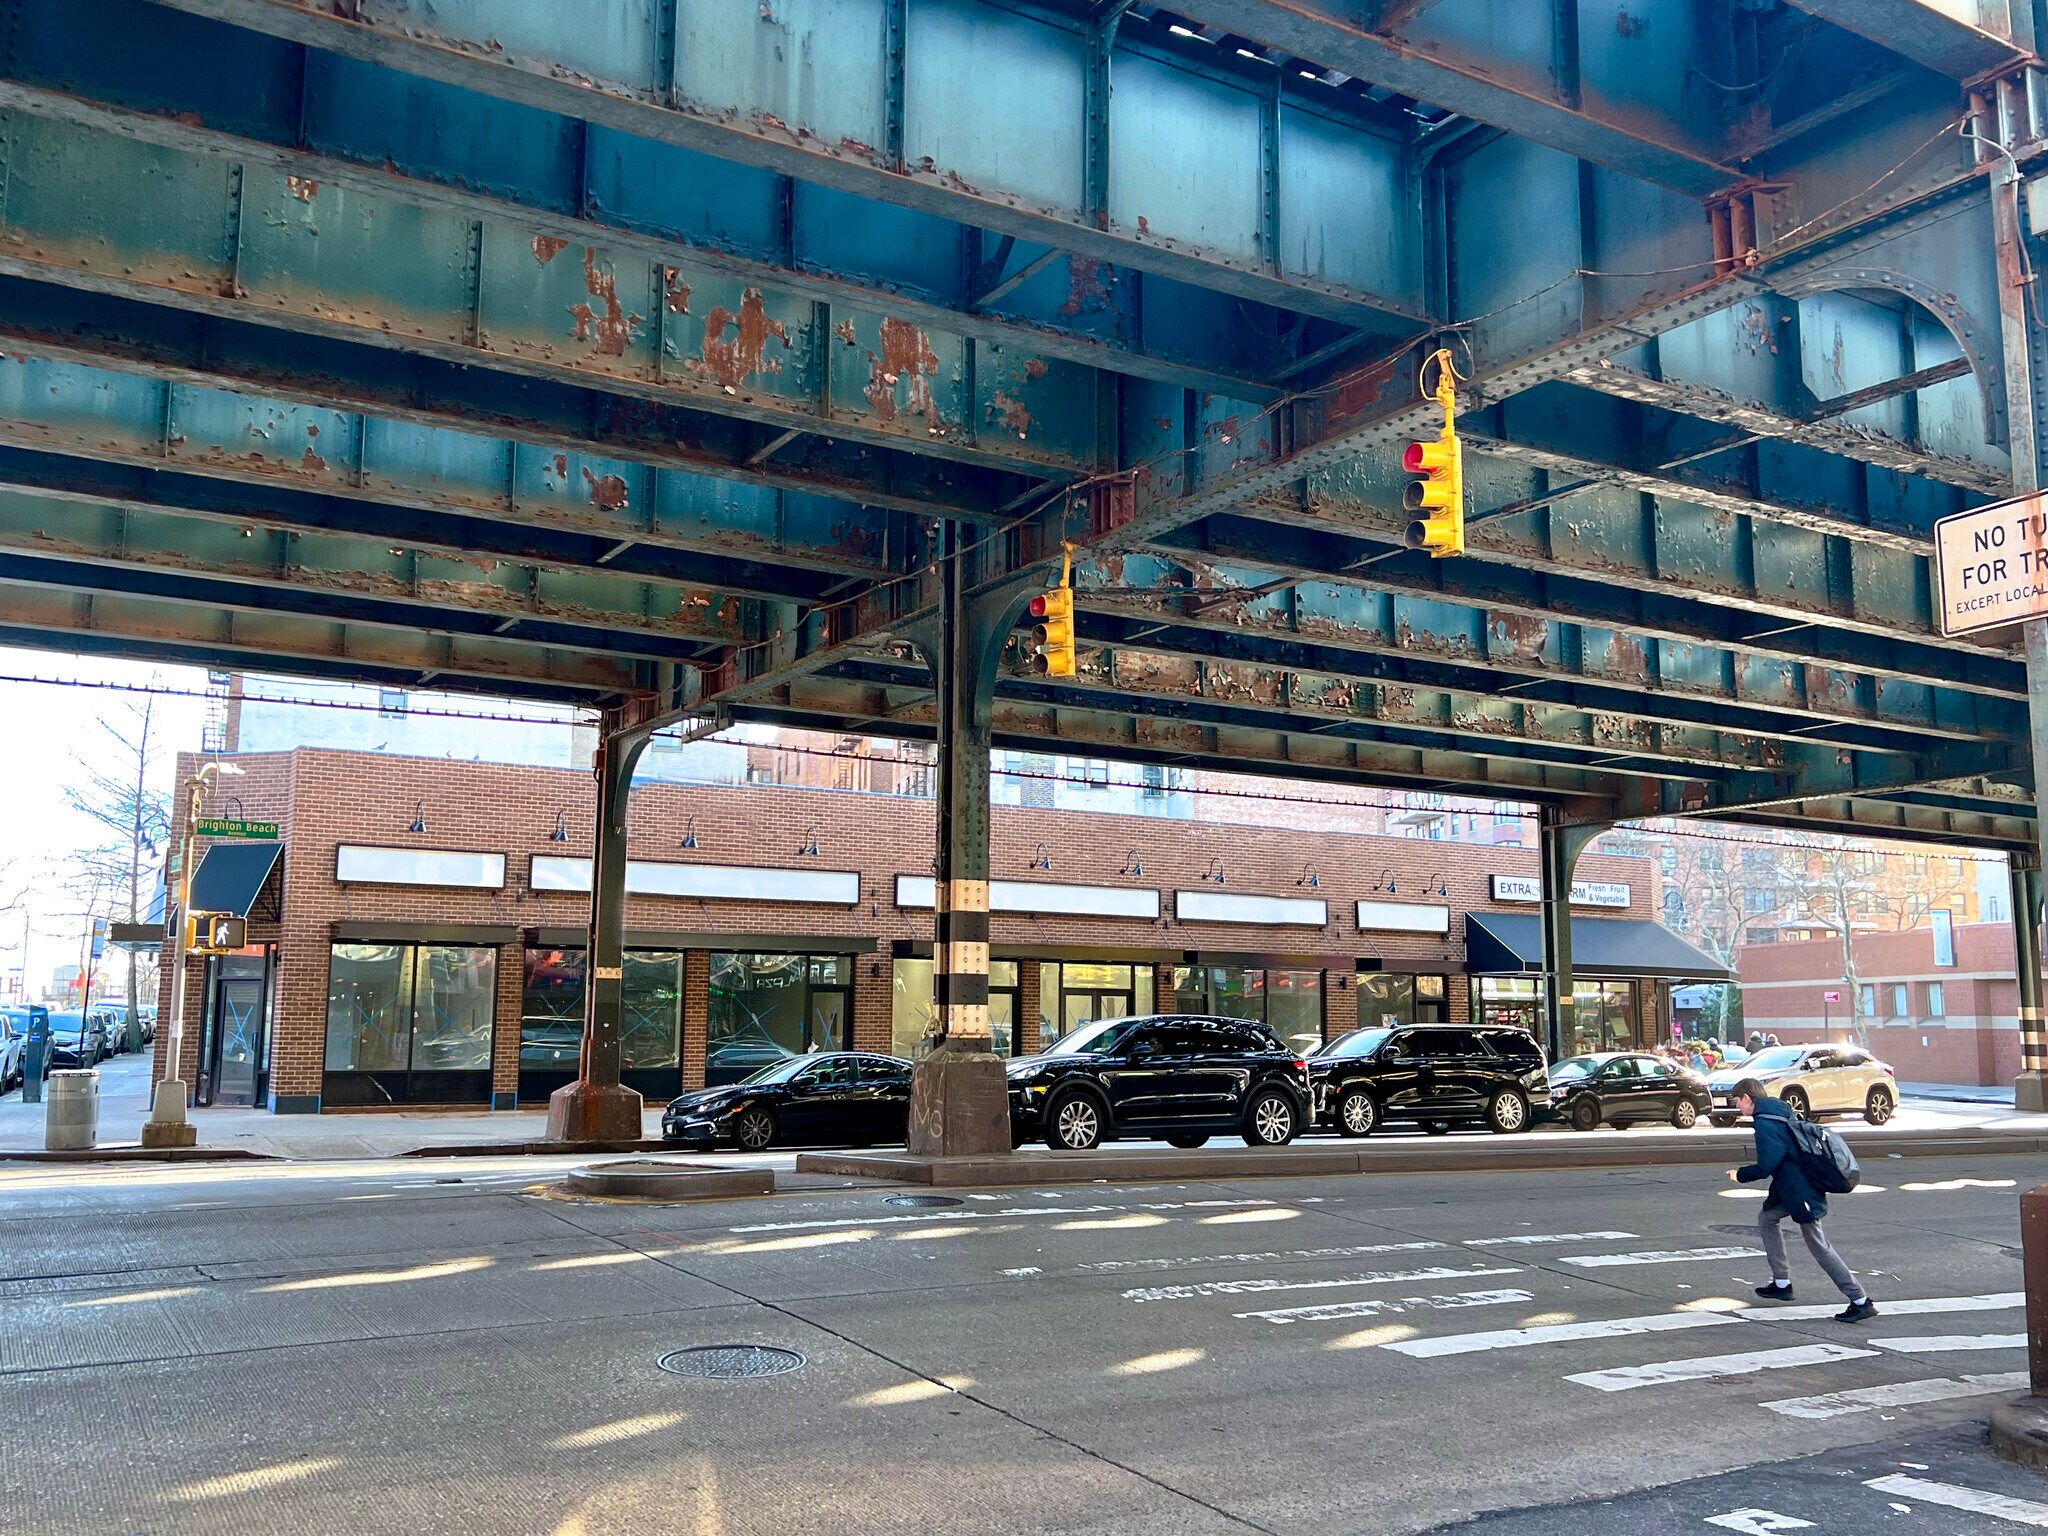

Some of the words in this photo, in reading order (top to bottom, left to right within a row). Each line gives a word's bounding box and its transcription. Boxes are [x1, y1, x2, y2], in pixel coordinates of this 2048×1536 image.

[1974, 525, 2005, 552] NO
[1963, 559, 2007, 589] FOR
[1956, 593, 2000, 614] EXCEPT
[2006, 583, 2048, 602] LOCAL
[198, 820, 242, 831] Brighton
[246, 823, 276, 833] Beach
[1500, 882, 1532, 895] EXTRA
[1569, 887, 1586, 899] RM
[1588, 883, 1607, 892] Fresh
[1610, 884, 1625, 893] Fruit
[1588, 893, 1594, 902] &
[1595, 893, 1626, 904] Vegetable
